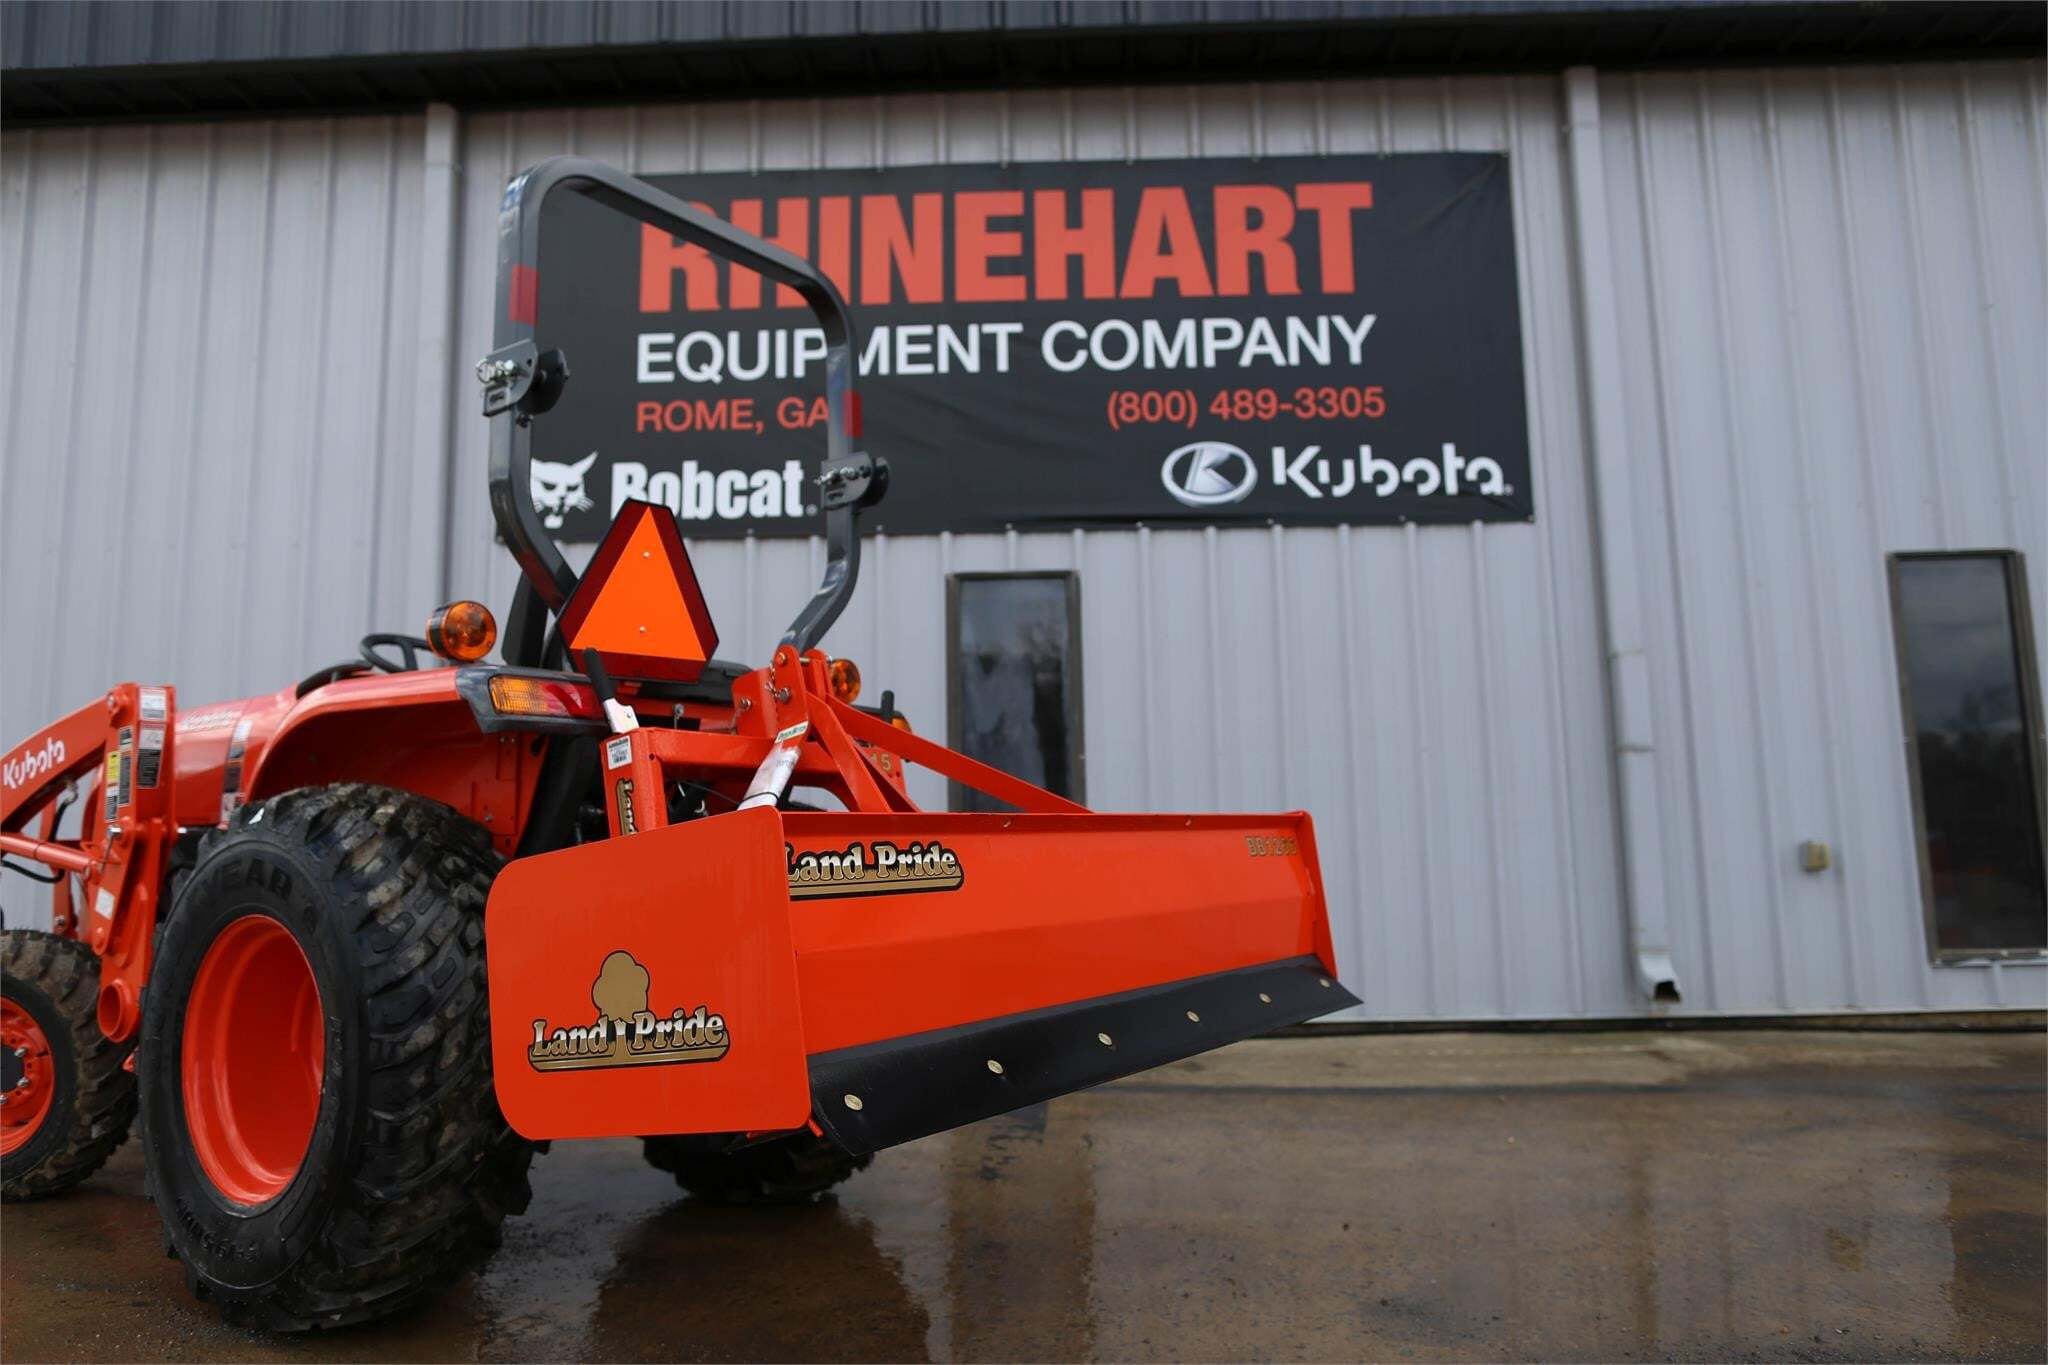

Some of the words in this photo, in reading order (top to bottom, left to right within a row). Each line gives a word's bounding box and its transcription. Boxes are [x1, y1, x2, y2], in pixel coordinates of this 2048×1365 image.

[640, 182, 1373, 313] RHINEHART
[636, 323, 1023, 384] EQUIPMENT
[1041, 314, 1377, 372] COMPANY
[636, 399, 764, 434] ROME,
[776, 396, 830, 430] GA
[1107, 390, 1198, 429] (800)
[1210, 386, 1387, 421] 489-3305
[611, 460, 803, 521] Bobcat
[1272, 442, 1503, 498] Kubota
[3, 737, 65, 790] Kubota
[785, 845, 865, 882] Land
[874, 842, 957, 879] Pride
[532, 1015, 609, 1057] Land
[631, 1006, 724, 1050] Pride
